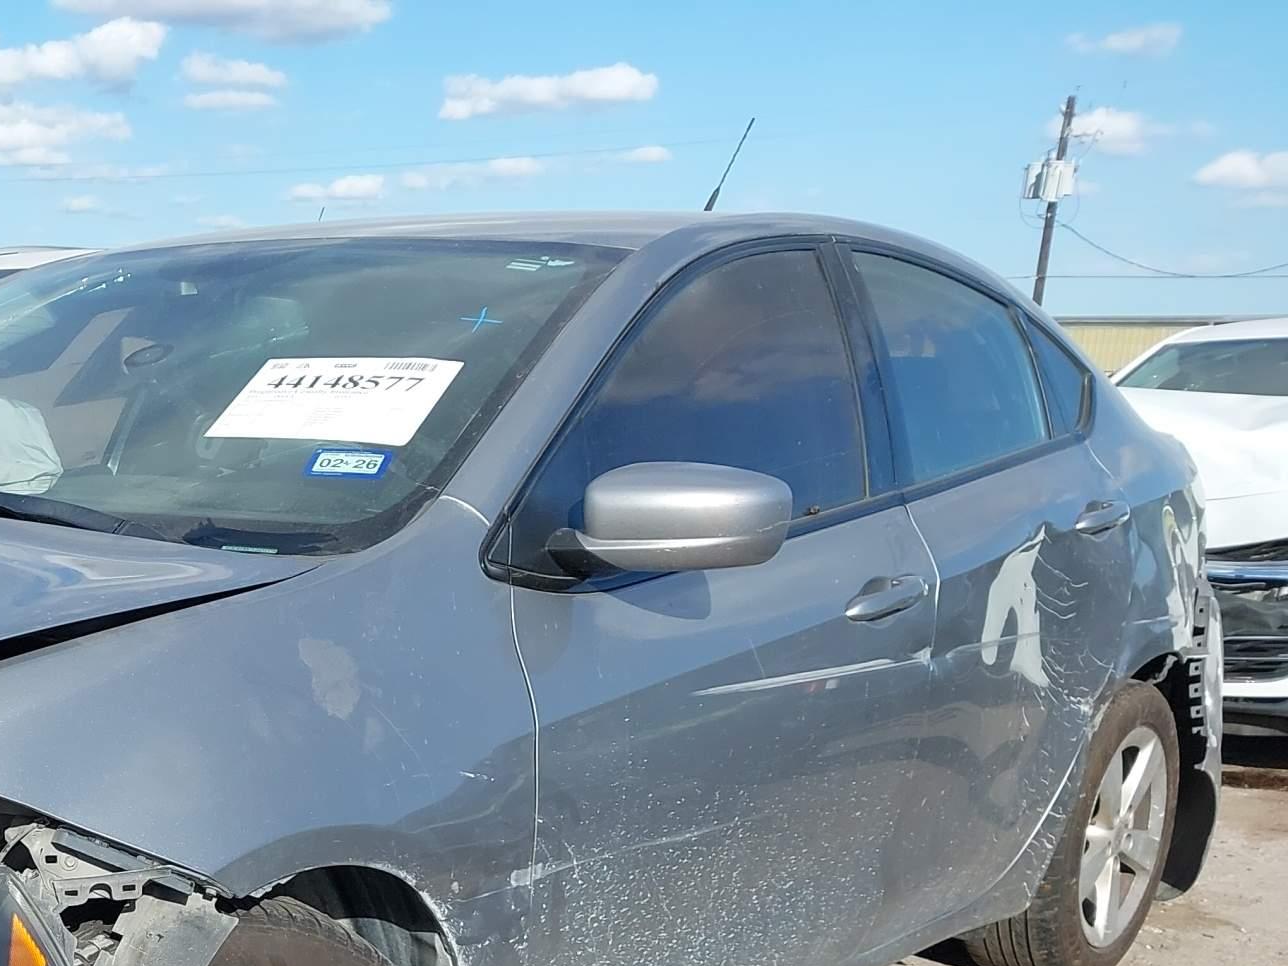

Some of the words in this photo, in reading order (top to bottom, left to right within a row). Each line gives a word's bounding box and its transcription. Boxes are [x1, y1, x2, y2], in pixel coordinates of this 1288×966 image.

[267, 374, 425, 392] 44148577
[318, 457, 344, 469] 02
[351, 458, 379, 470] 26
